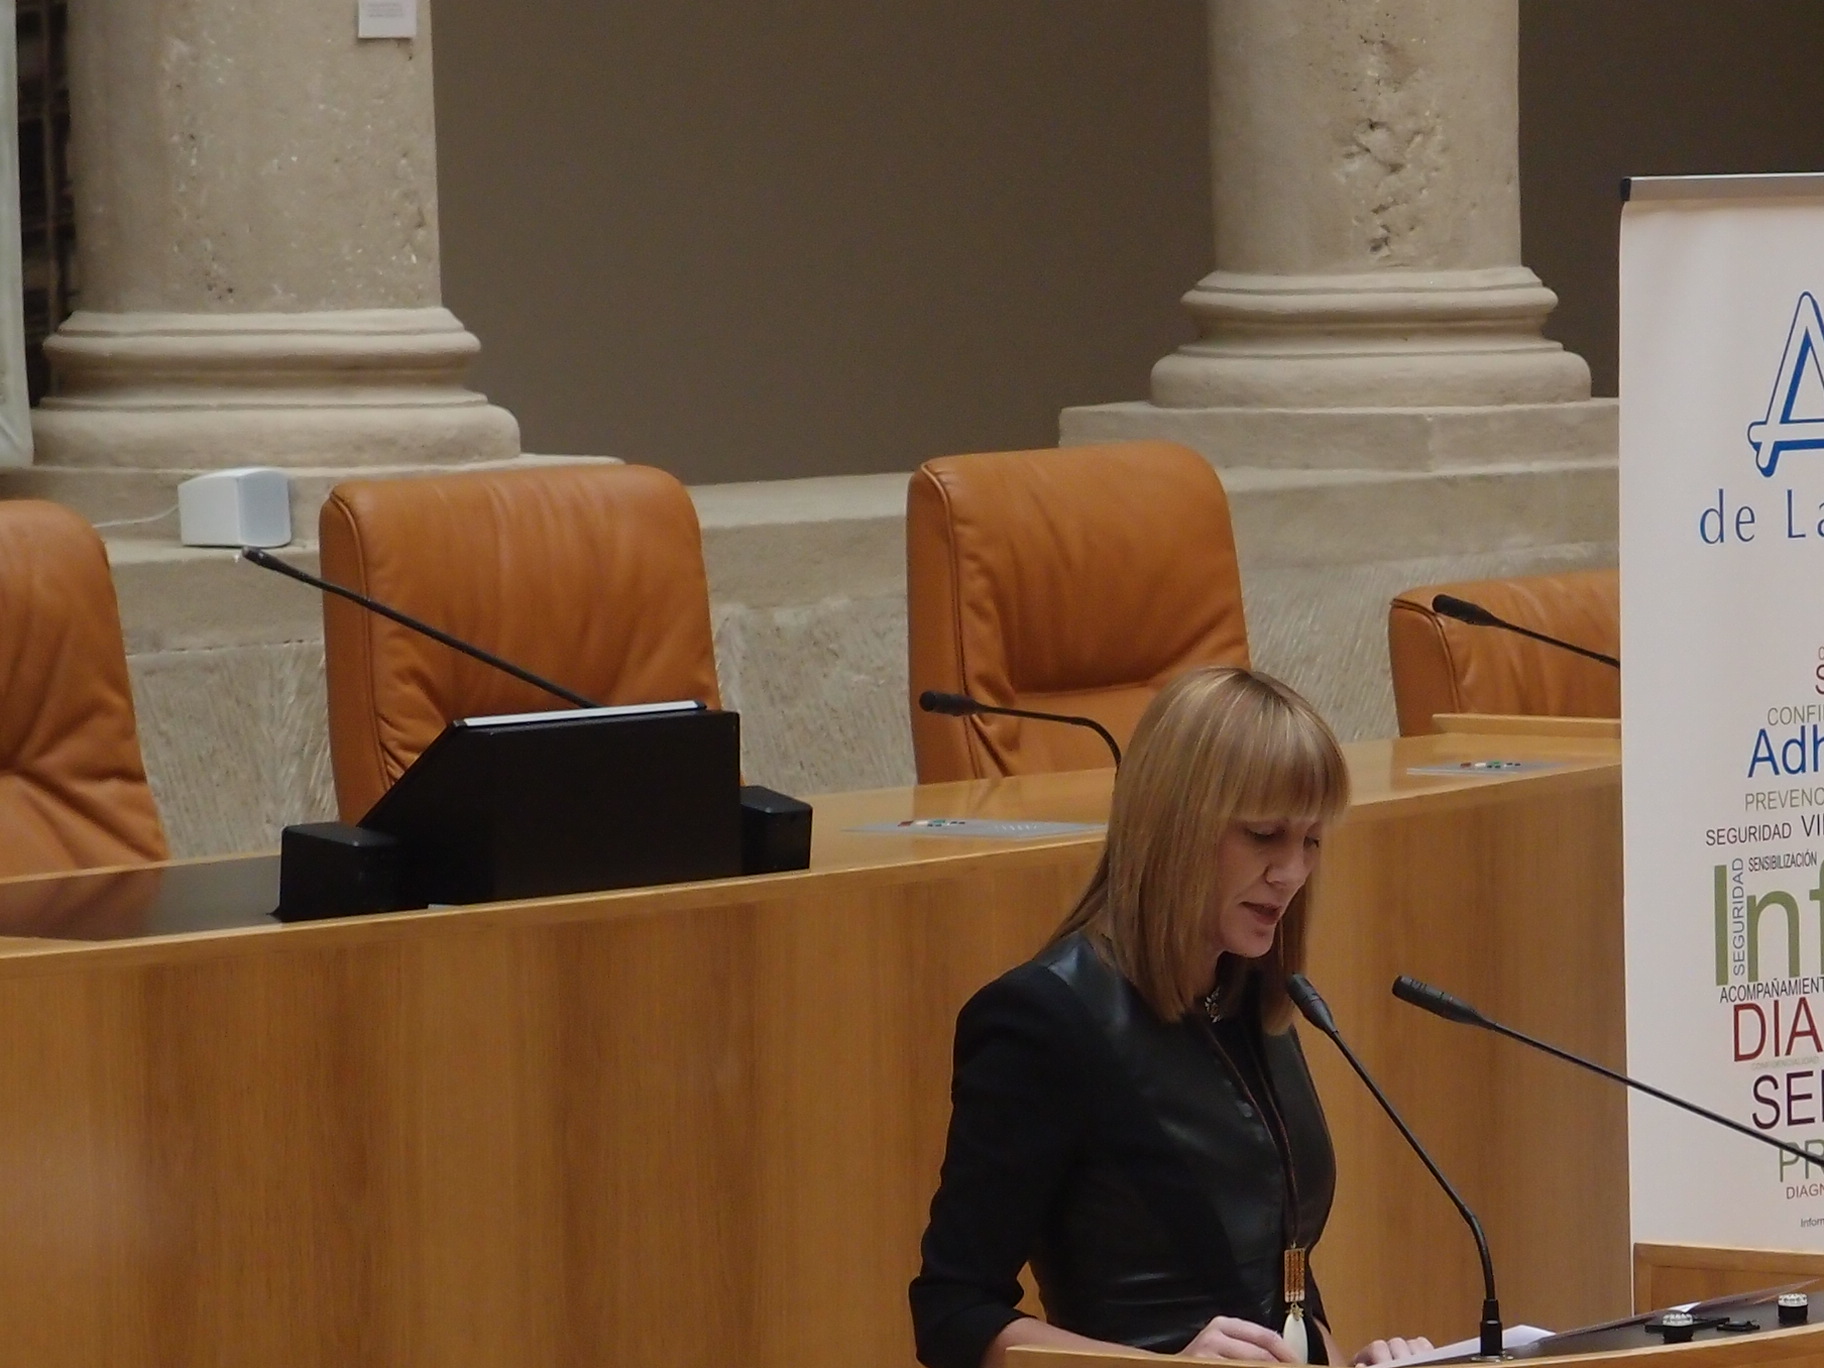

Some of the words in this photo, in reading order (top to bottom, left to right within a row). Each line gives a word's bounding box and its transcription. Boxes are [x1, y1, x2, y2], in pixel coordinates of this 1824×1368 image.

[1700, 488, 1755, 544] de
[1706, 822, 1792, 846] SEGURIDAD
[1748, 849, 1818, 872] SENSIBILIZACIÓN
[1732, 858, 1745, 976] SEGURIDAD
